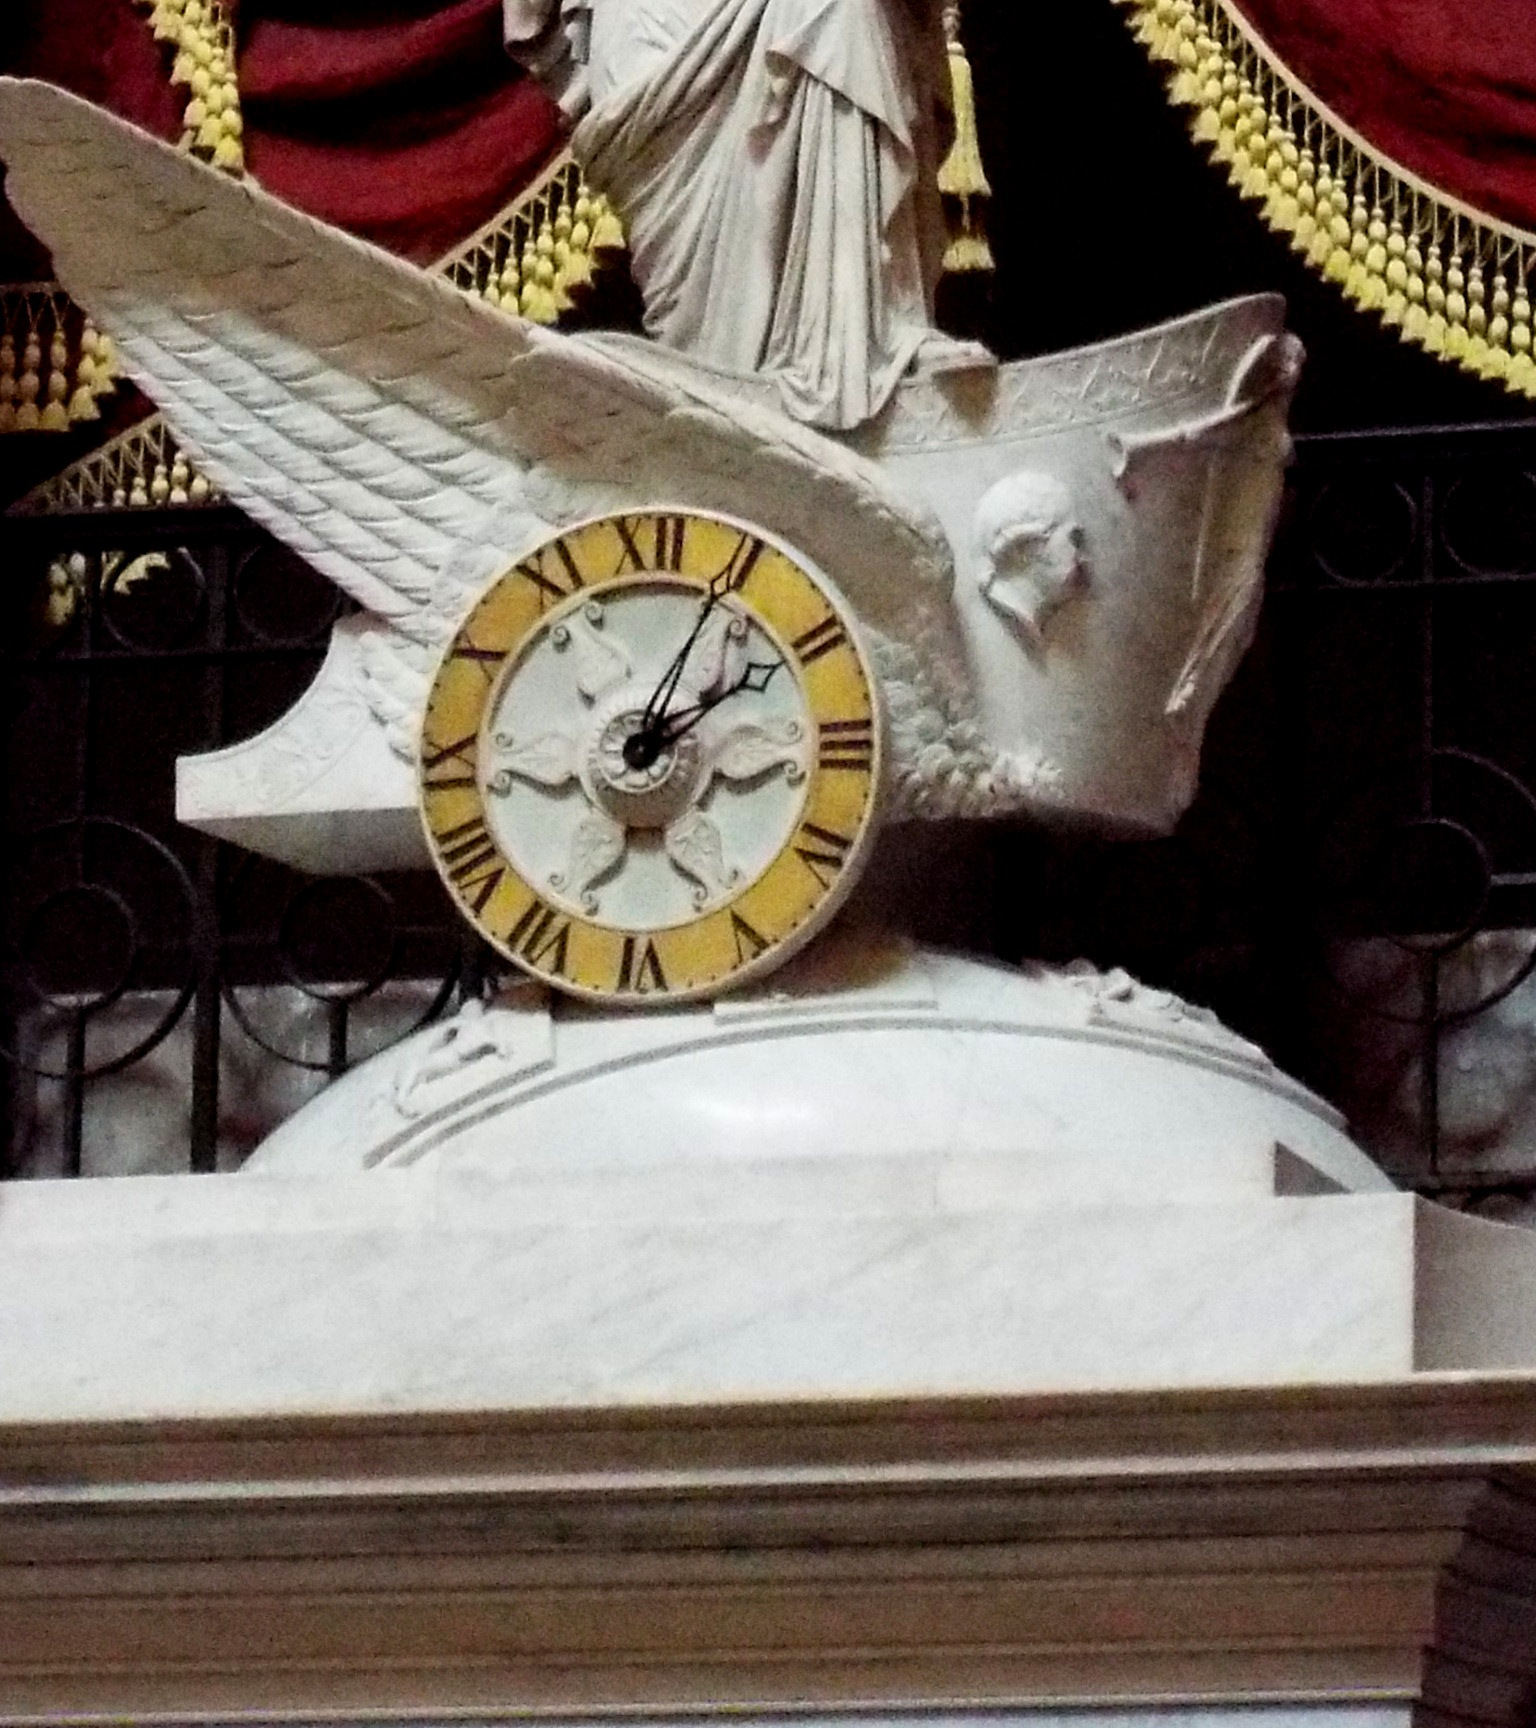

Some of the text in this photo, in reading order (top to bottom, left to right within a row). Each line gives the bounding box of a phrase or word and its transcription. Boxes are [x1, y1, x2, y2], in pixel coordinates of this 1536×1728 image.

[614, 516, 686, 572] XII
[515, 538, 586, 614] XI
[451, 627, 508, 685] X
[790, 614, 848, 664] II
[421, 731, 479, 789] IX
[819, 719, 873, 770] III
[436, 818, 507, 919] VIII
[792, 822, 855, 892] IV
[508, 899, 572, 975] VII
[616, 936, 669, 993] VI
[729, 907, 771, 969] V
